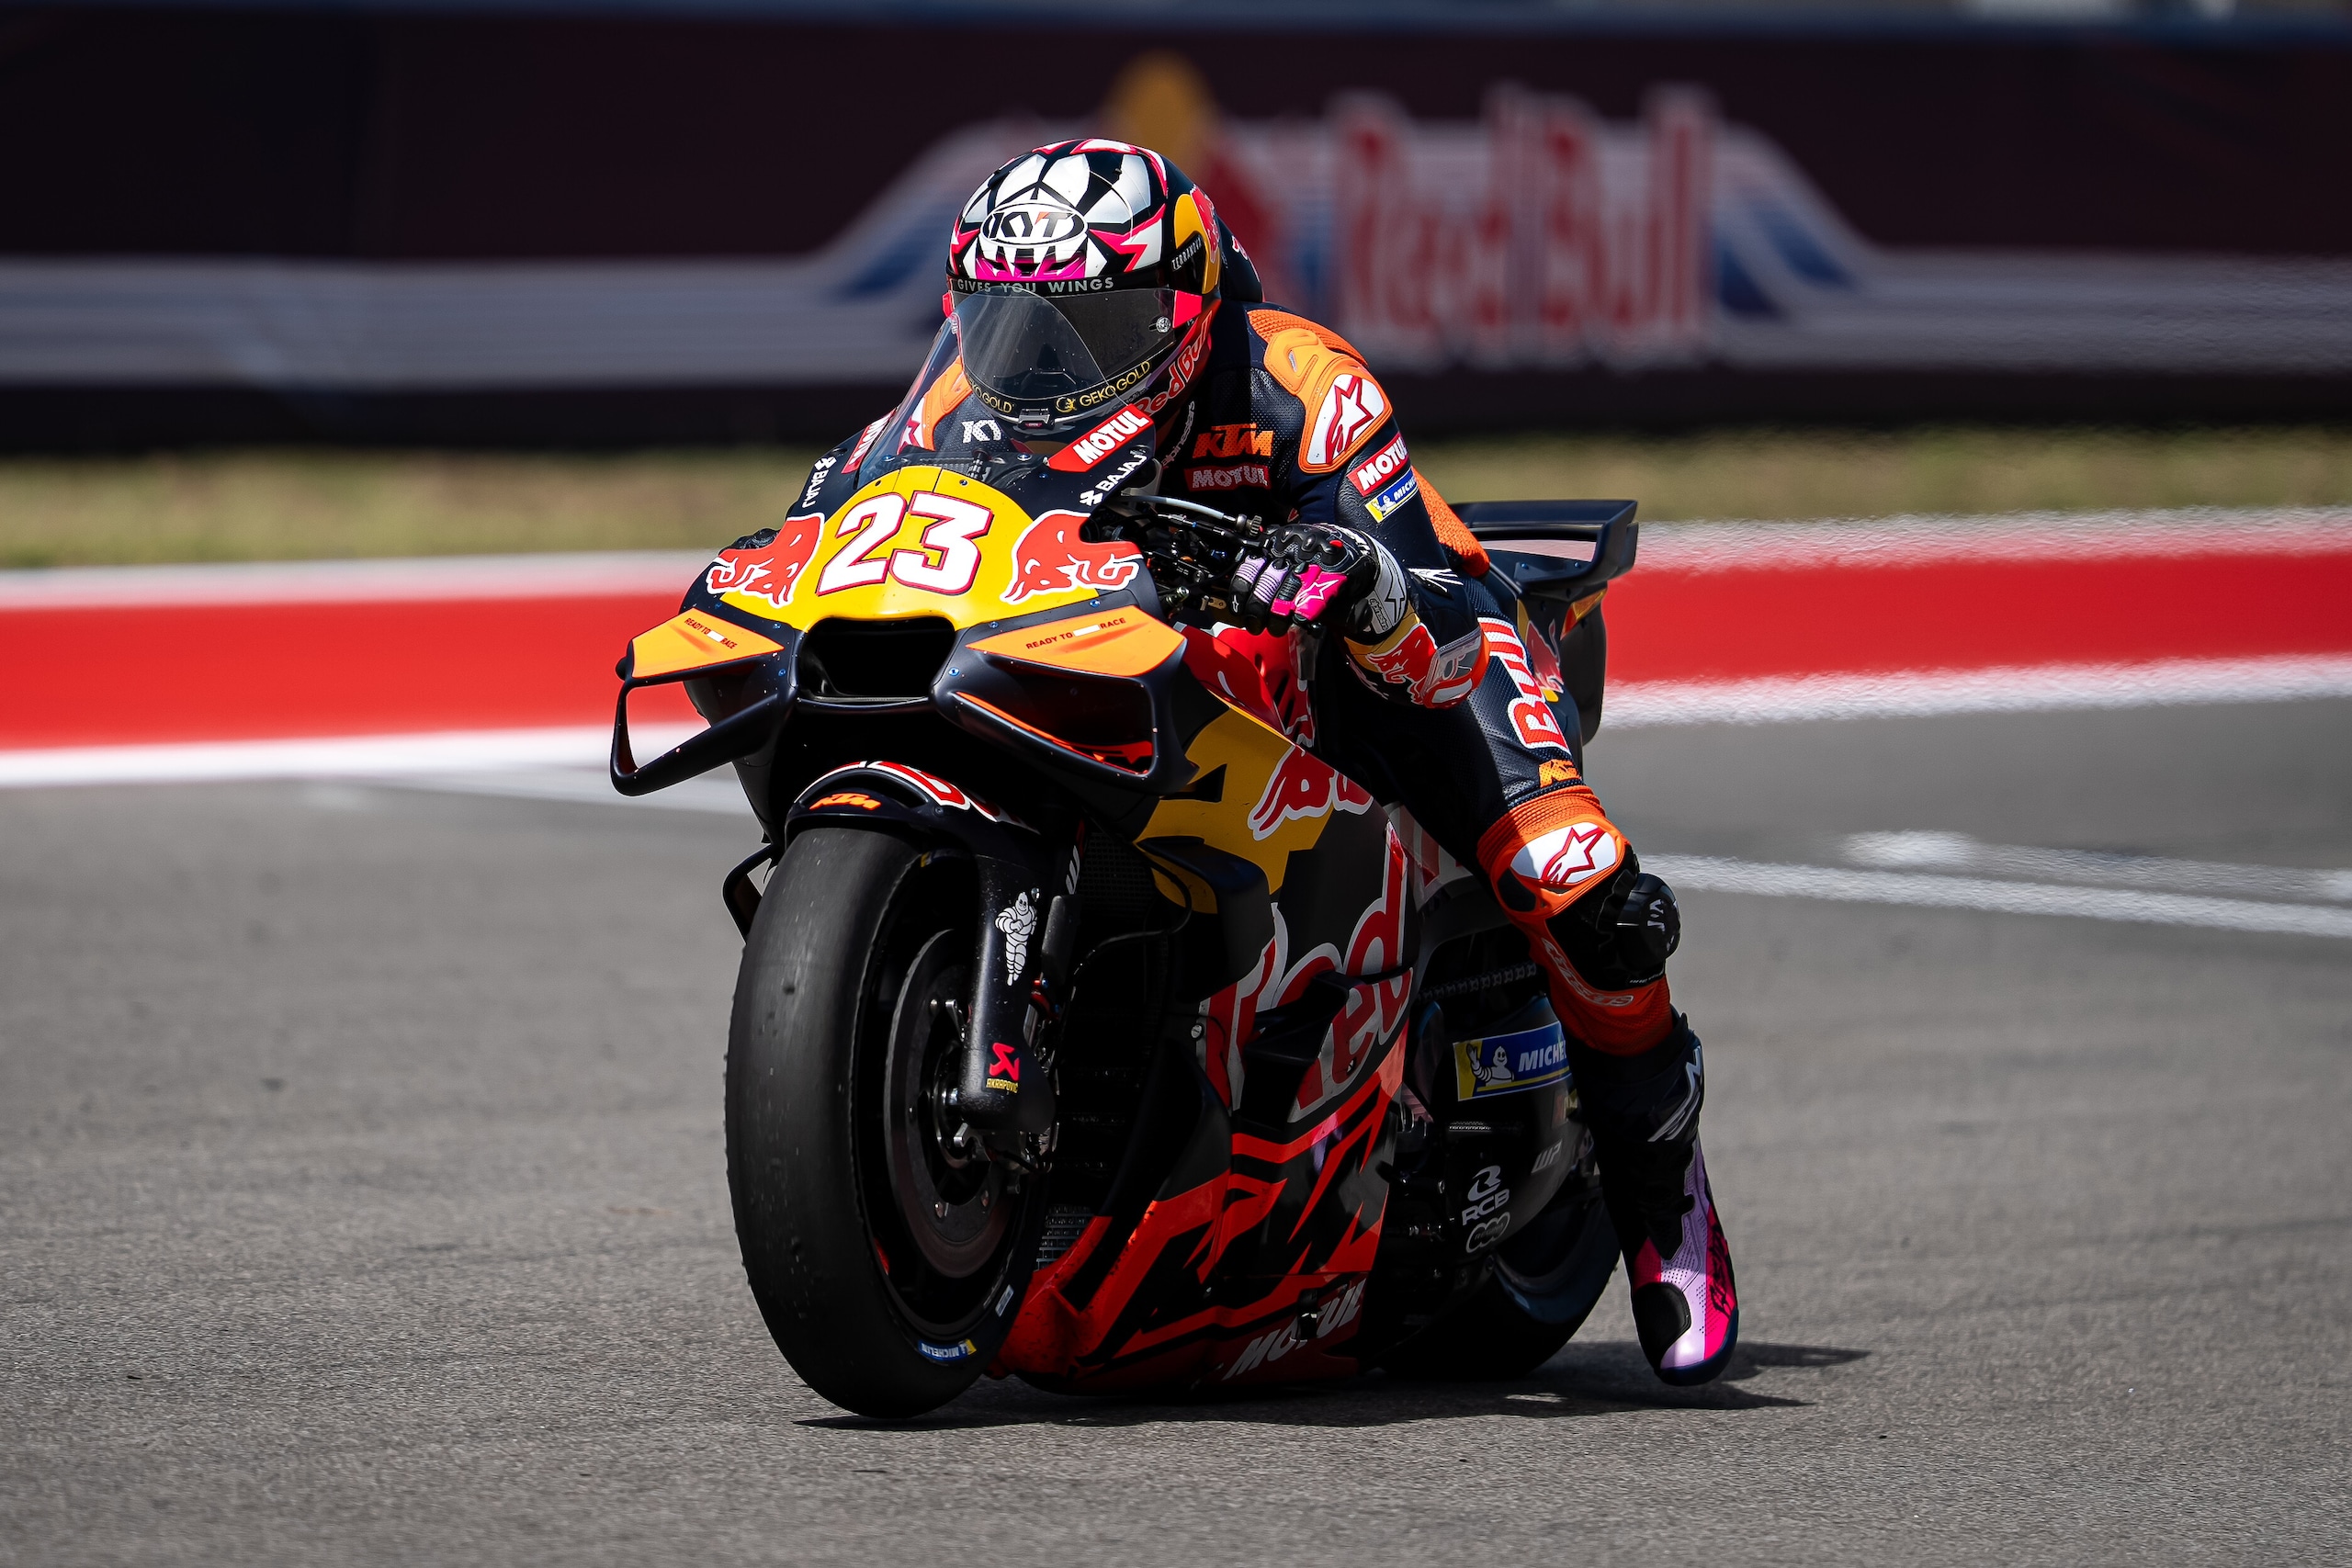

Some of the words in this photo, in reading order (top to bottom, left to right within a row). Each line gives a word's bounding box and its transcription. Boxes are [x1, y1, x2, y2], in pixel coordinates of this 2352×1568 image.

[989, 211, 1075, 238] KYT
[1171, 235, 1202, 270] TERRANOVA
[957, 278, 990, 293] GIVES
[1001, 282, 1036, 293] YOU
[1047, 277, 1114, 293] WINGS
[1080, 385, 1115, 406] GEKO
[1116, 361, 1150, 390] GOLD
[982, 392, 1012, 413] GOLD
[1072, 410, 1149, 465] MOTUL
[1193, 423, 1274, 458] KTM
[802, 469, 829, 508] BAJAJ
[1095, 454, 1148, 491] BAJAJ
[1193, 465, 1268, 489] MOTUL
[815, 491, 994, 597] 23
[684, 617, 704, 631] READY
[701, 626, 711, 635] TO
[719, 637, 738, 649] RACE
[1025, 636, 1057, 649] READY
[1059, 632, 1073, 640] TO
[1100, 617, 1126, 629] RACE
[1477, 616, 1573, 757] Bull
[809, 792, 881, 810] KTM
[1462, 1189, 1510, 1226] RCB
